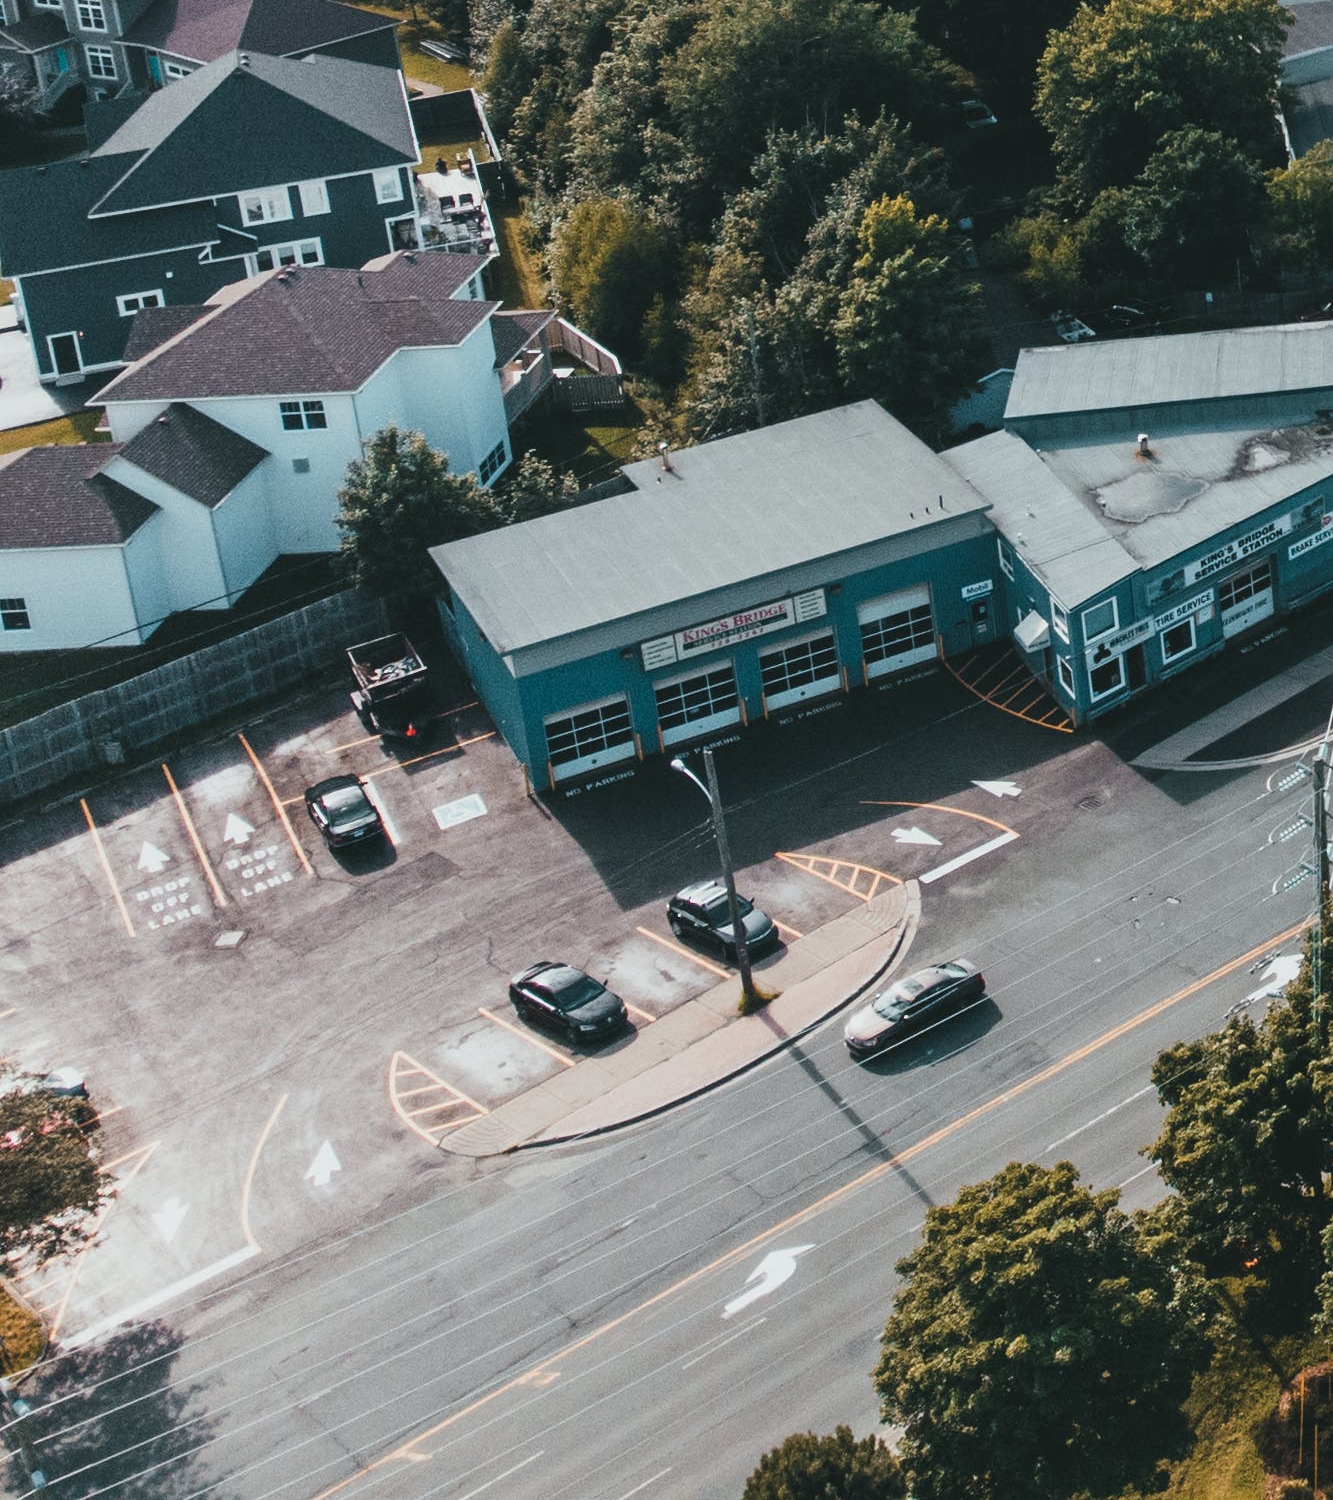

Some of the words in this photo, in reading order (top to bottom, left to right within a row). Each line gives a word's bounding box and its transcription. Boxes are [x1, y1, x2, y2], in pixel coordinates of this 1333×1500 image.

[1200, 545, 1234, 568] KING'S
[1238, 523, 1276, 548] BRIDGE
[1290, 539, 1314, 556] BRAKE
[1194, 552, 1238, 580] SERVICE
[966, 582, 989, 595] Mobil
[733, 603, 786, 627] BRIDGE
[1156, 610, 1175, 627] TIRE
[1177, 591, 1212, 617] SERVICE
[778, 716, 794, 726] NO
[798, 700, 843, 719] PARKING
[694, 734, 741, 755] PARKING
[565, 787, 582, 798] NO
[586, 770, 635, 791] PARKING
[227, 845, 279, 870] DROP
[242, 859, 277, 879] OFF
[136, 877, 191, 902] DROP
[241, 871, 294, 897] LANE
[151, 892, 191, 913] OFF
[148, 904, 202, 930] LANE
